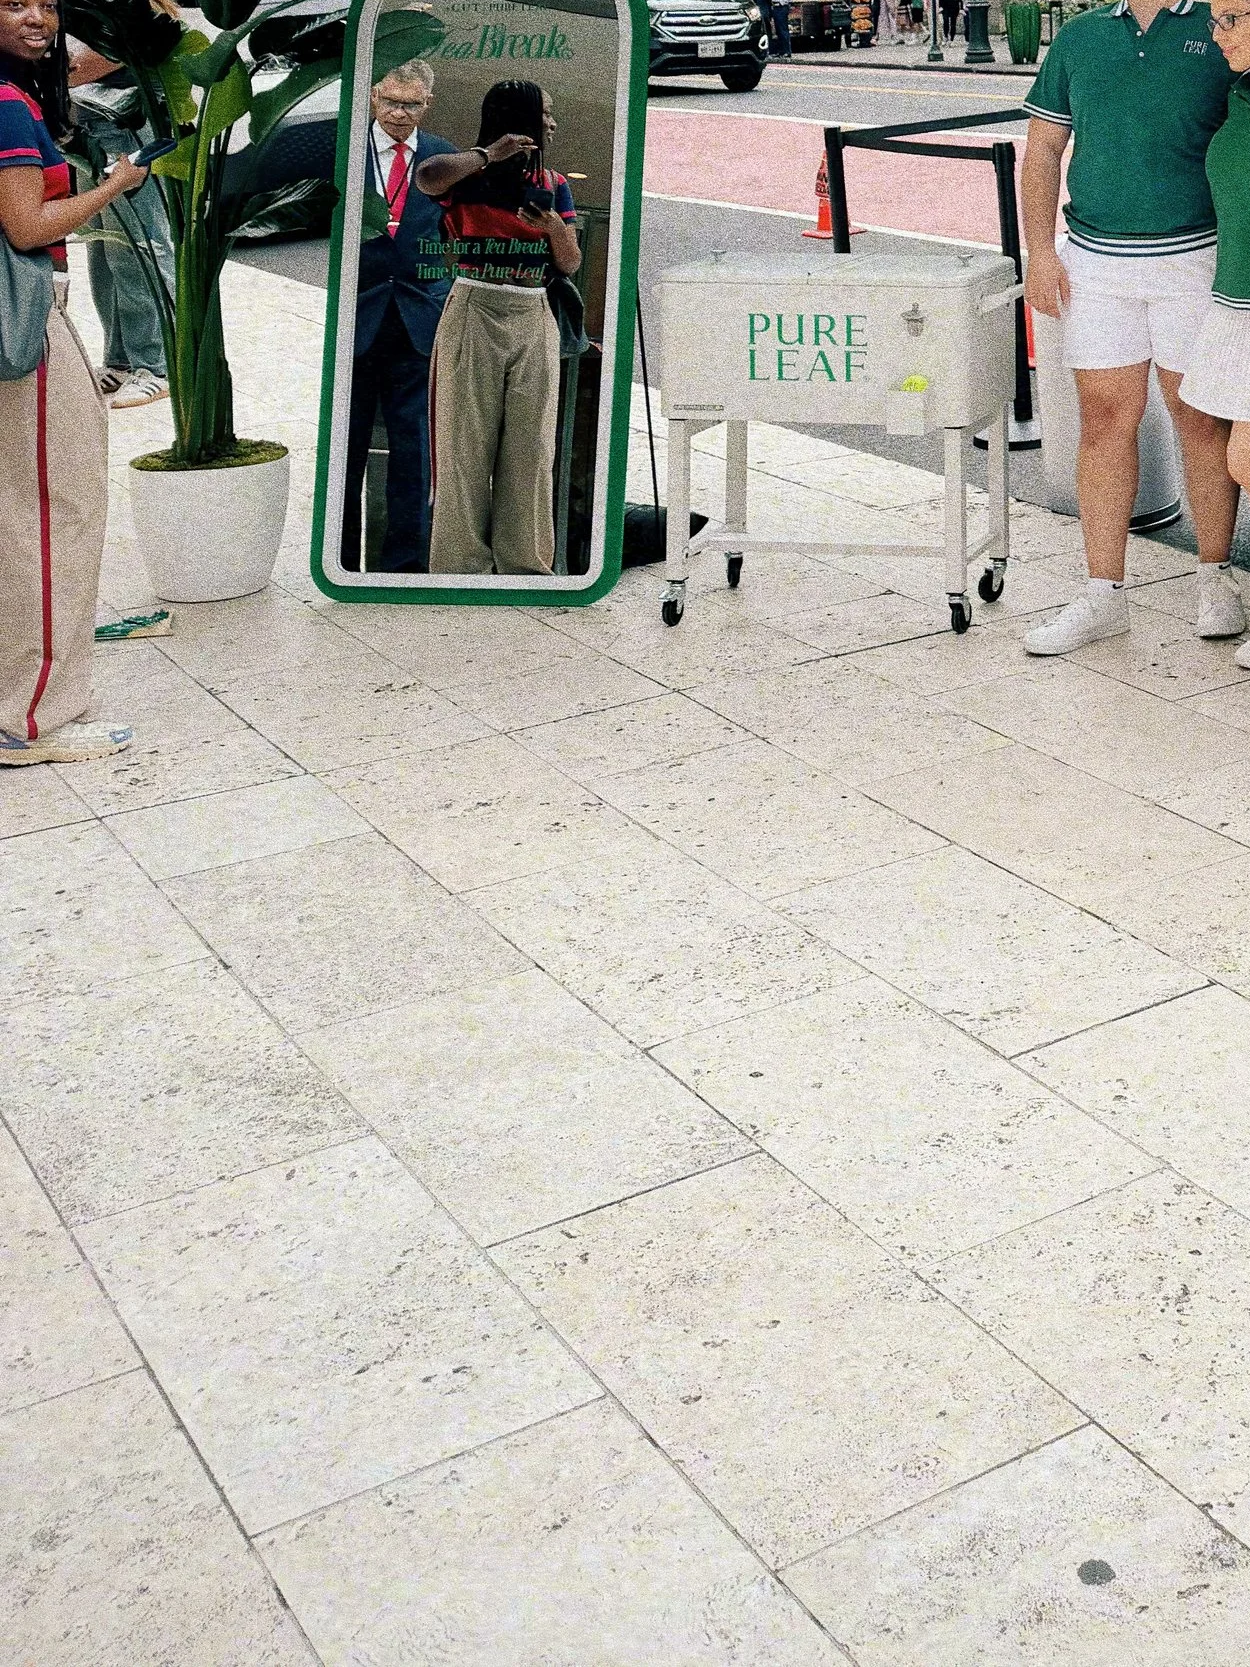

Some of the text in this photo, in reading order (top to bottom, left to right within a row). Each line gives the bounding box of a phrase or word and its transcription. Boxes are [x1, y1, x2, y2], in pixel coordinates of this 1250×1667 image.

[417, 238, 450, 254] Time
[453, 237, 471, 254] for
[472, 243, 480, 254] a
[485, 238, 505, 254] Tea
[416, 263, 448, 279] Time
[471, 267, 480, 278] a
[481, 263, 514, 279] Pure
[747, 313, 869, 347] PURE
